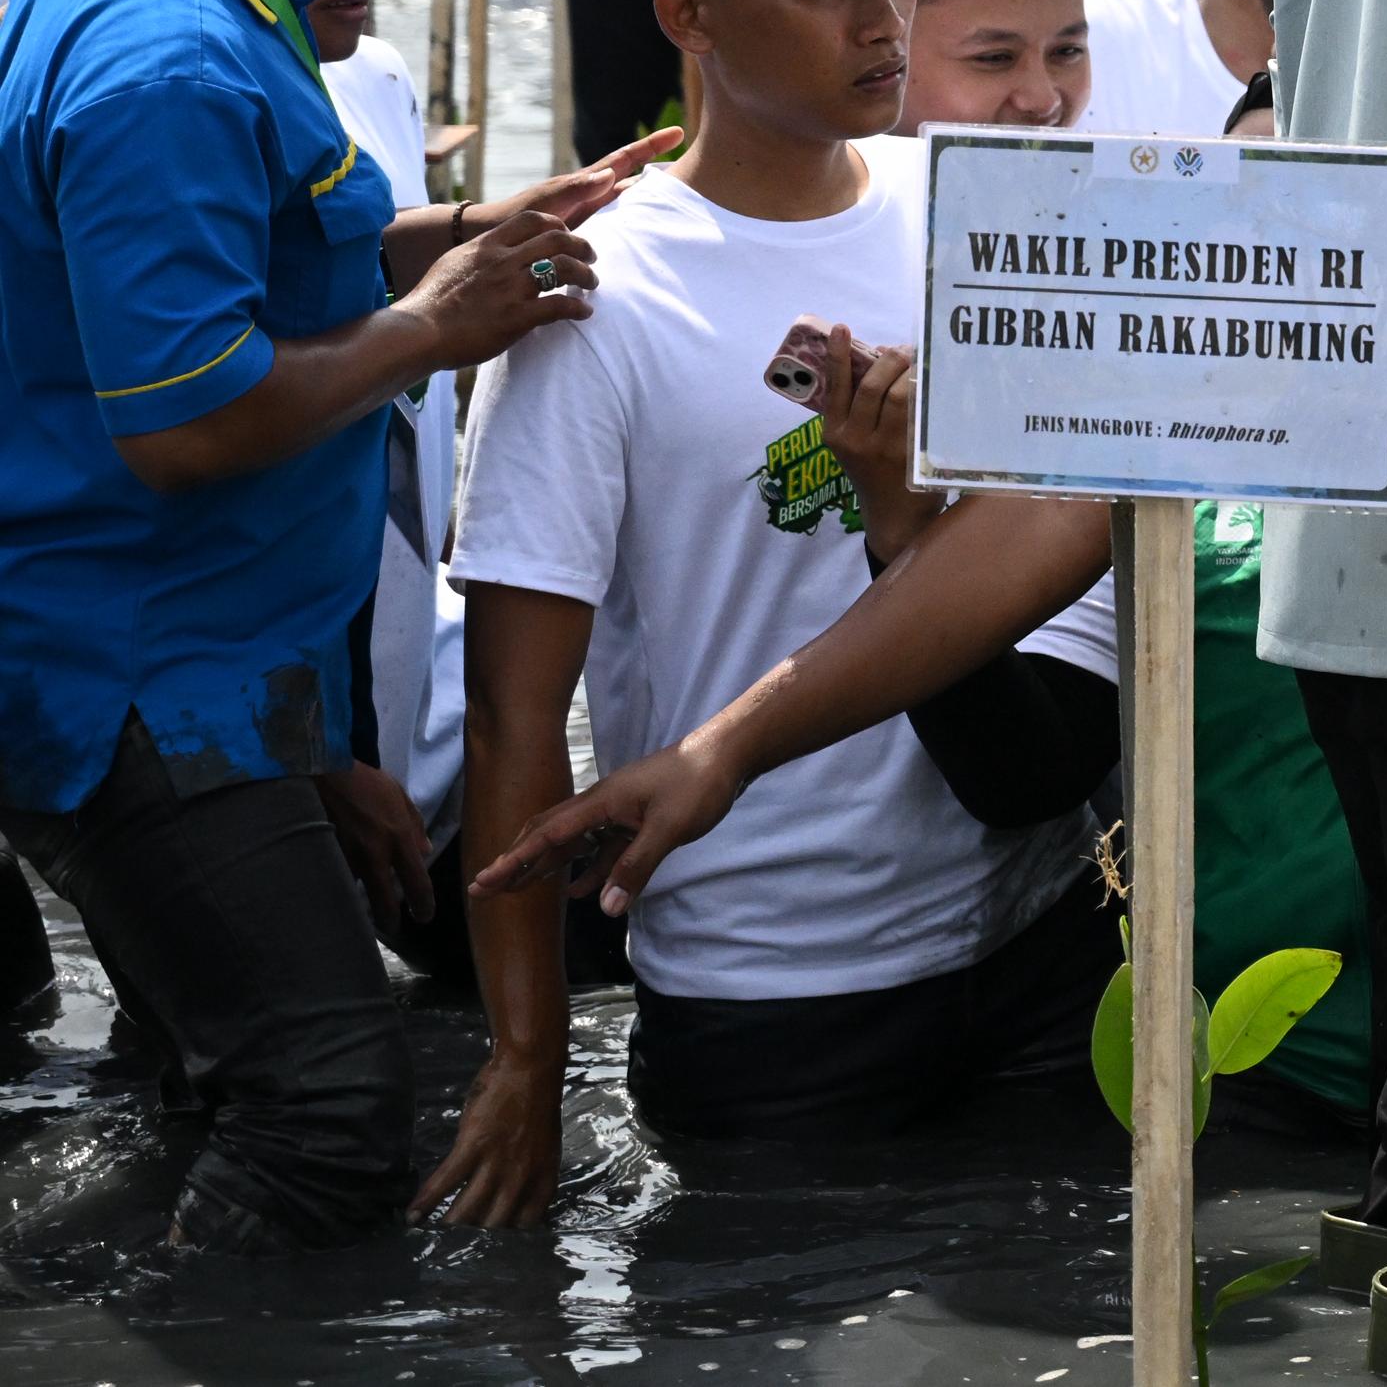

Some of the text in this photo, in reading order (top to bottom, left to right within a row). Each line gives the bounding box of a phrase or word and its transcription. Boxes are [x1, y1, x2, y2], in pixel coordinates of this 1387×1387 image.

[968, 231, 1365, 290] WAKIL PRESIDEN RI
[949, 305, 1376, 365] GIBRAN RAKABUMING
[1024, 415, 1065, 434] JENIS
[1068, 416, 1153, 438] MANGROVE
[1167, 422, 1266, 443] Rhizophora
[1267, 427, 1290, 446] sp.
